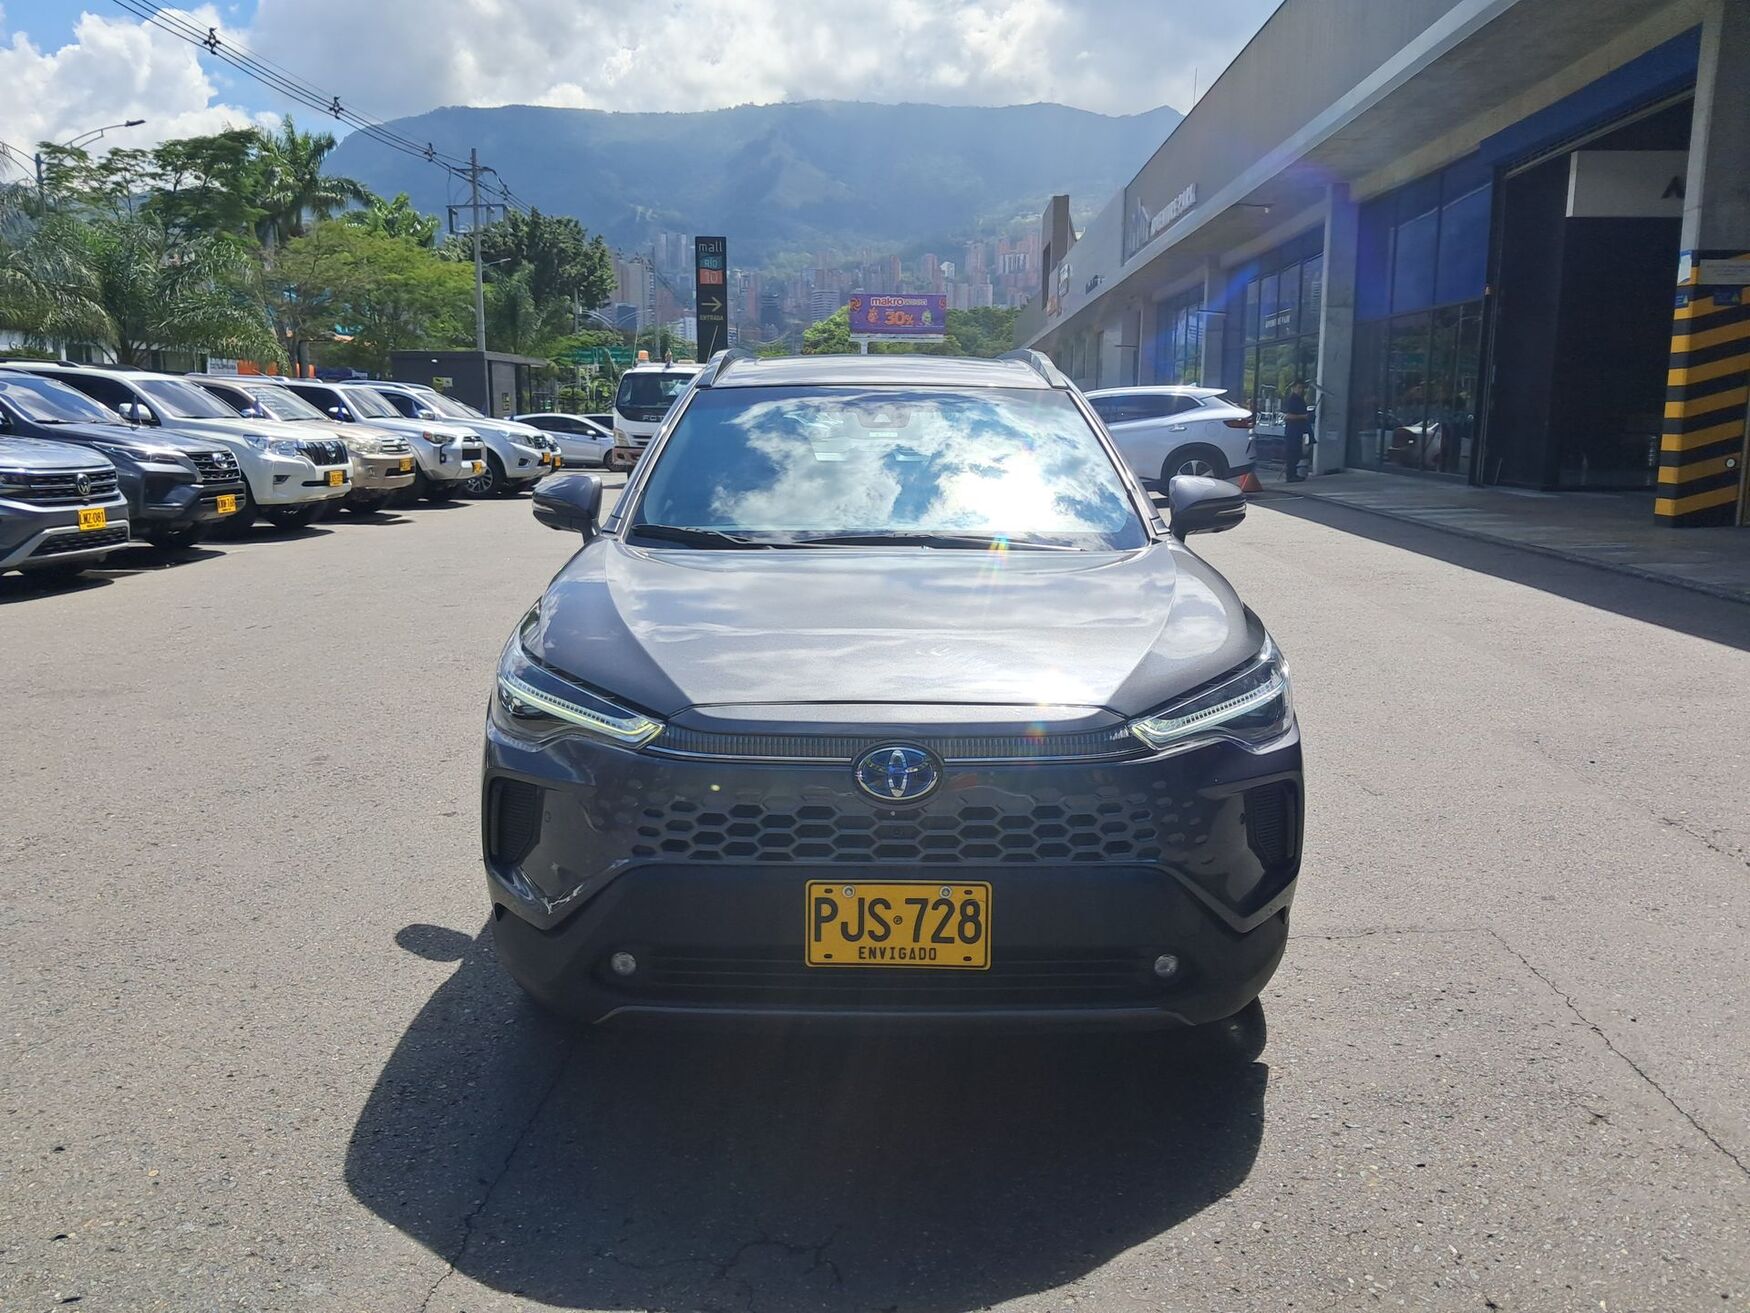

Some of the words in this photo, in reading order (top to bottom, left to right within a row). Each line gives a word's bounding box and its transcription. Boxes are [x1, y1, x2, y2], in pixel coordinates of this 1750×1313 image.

[699, 241, 723, 252] mall
[870, 296, 904, 306] makro
[858, 946, 937, 960] ENVIGADO
